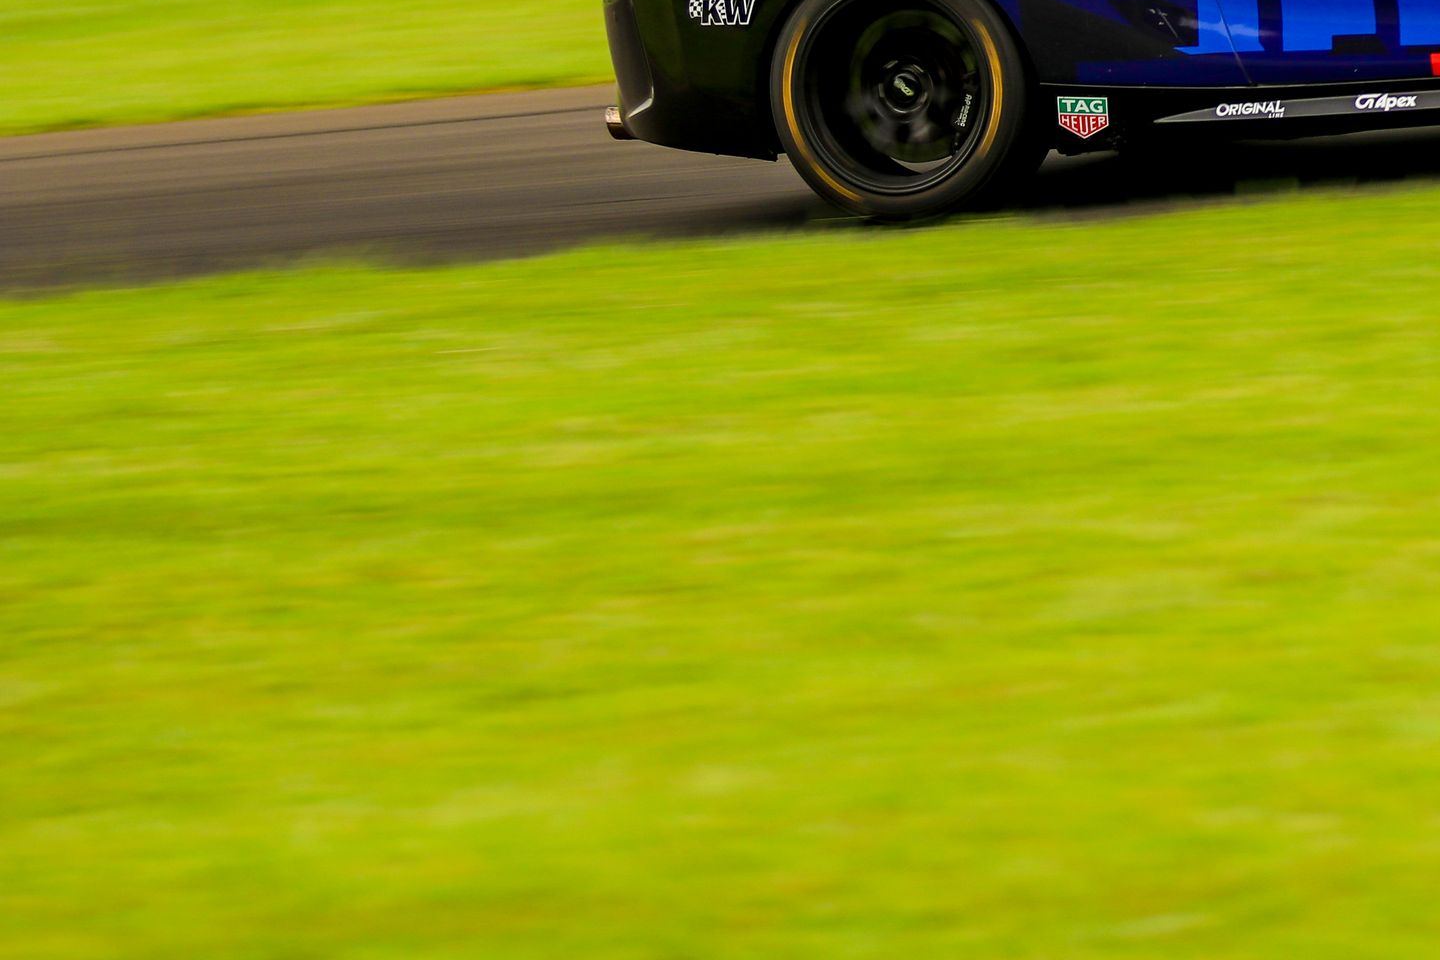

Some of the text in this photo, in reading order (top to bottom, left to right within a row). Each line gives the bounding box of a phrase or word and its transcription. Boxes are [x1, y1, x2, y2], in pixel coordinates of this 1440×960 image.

[1061, 100, 1104, 113] TAG
[1216, 100, 1285, 116] ORIGINAL
[1061, 115, 1106, 135] HEUER
